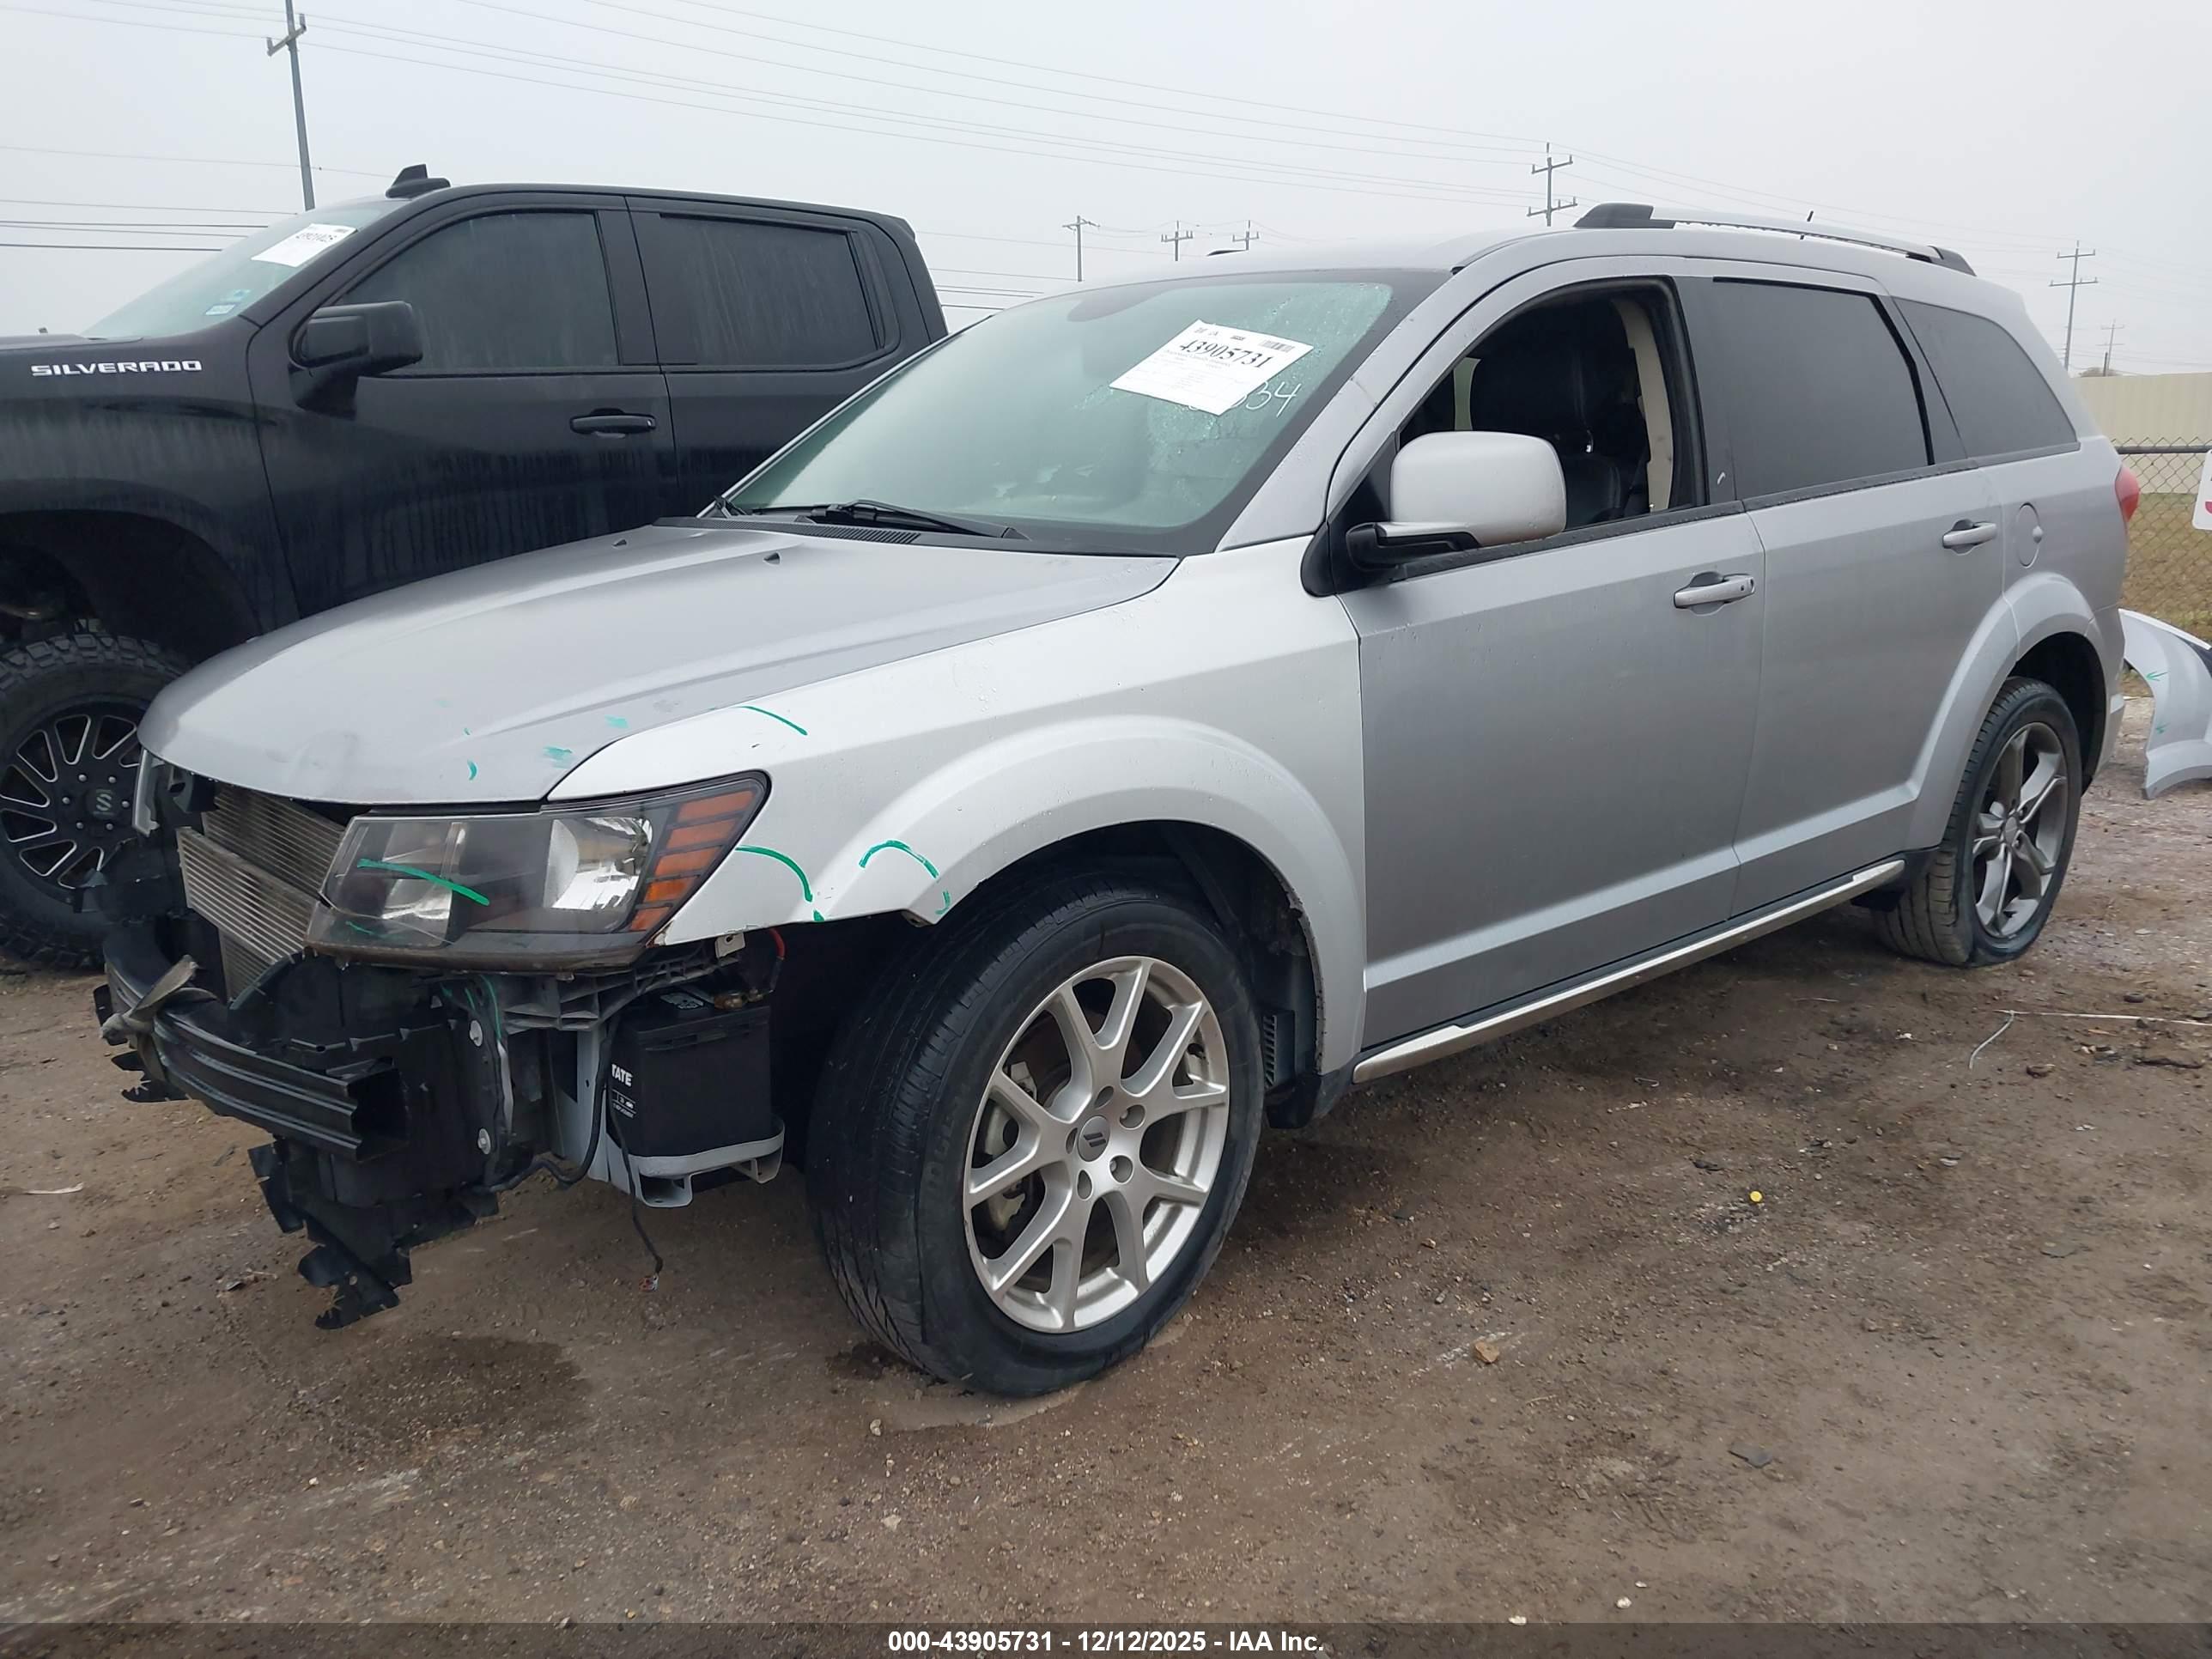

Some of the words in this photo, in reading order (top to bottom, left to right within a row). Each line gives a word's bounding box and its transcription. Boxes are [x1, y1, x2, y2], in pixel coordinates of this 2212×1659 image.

[30, 360, 203, 376] SILVERADO
[1179, 338, 1276, 368] 43905731
[1231, 380, 1302, 417] 34
